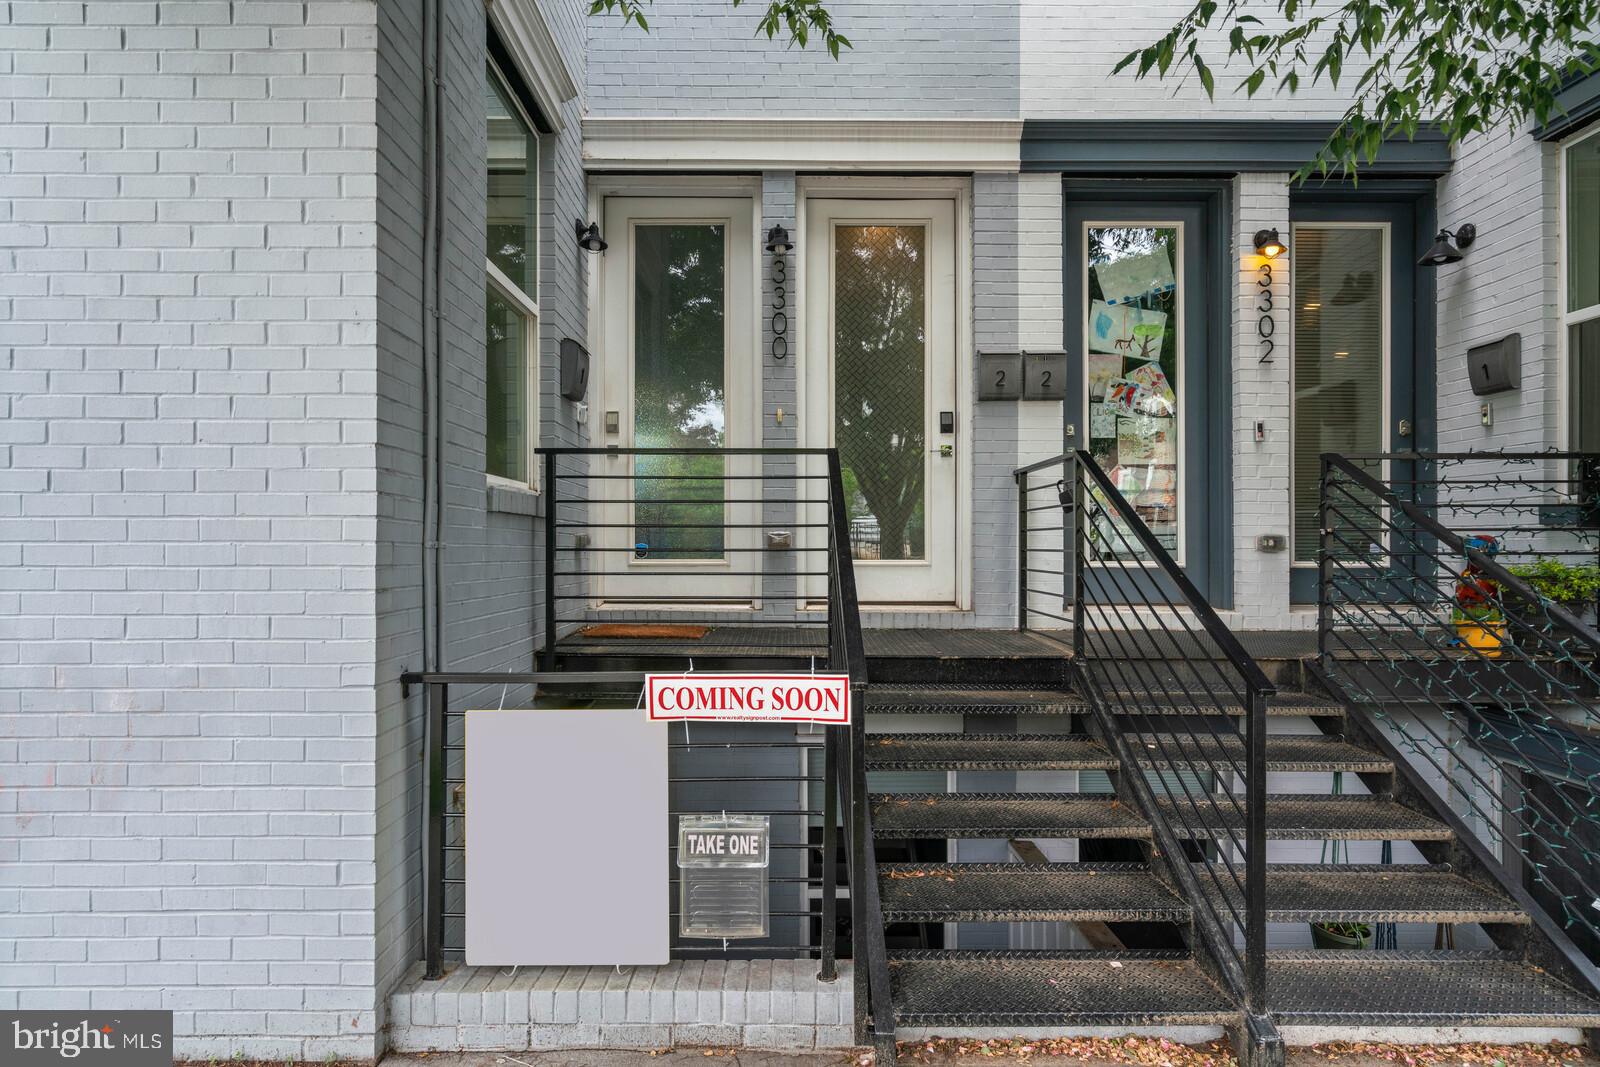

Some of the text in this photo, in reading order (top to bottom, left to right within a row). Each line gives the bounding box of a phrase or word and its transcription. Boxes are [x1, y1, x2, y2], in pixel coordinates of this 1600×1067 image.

[772, 260, 788, 360] 3300
[1257, 264, 1275, 364] 3302
[995, 370, 1006, 387] 2
[1041, 370, 1052, 388] 2
[1481, 363, 1490, 381] 1
[657, 686, 842, 712] COMING SOON
[687, 834, 759, 855] TAKE ONE
